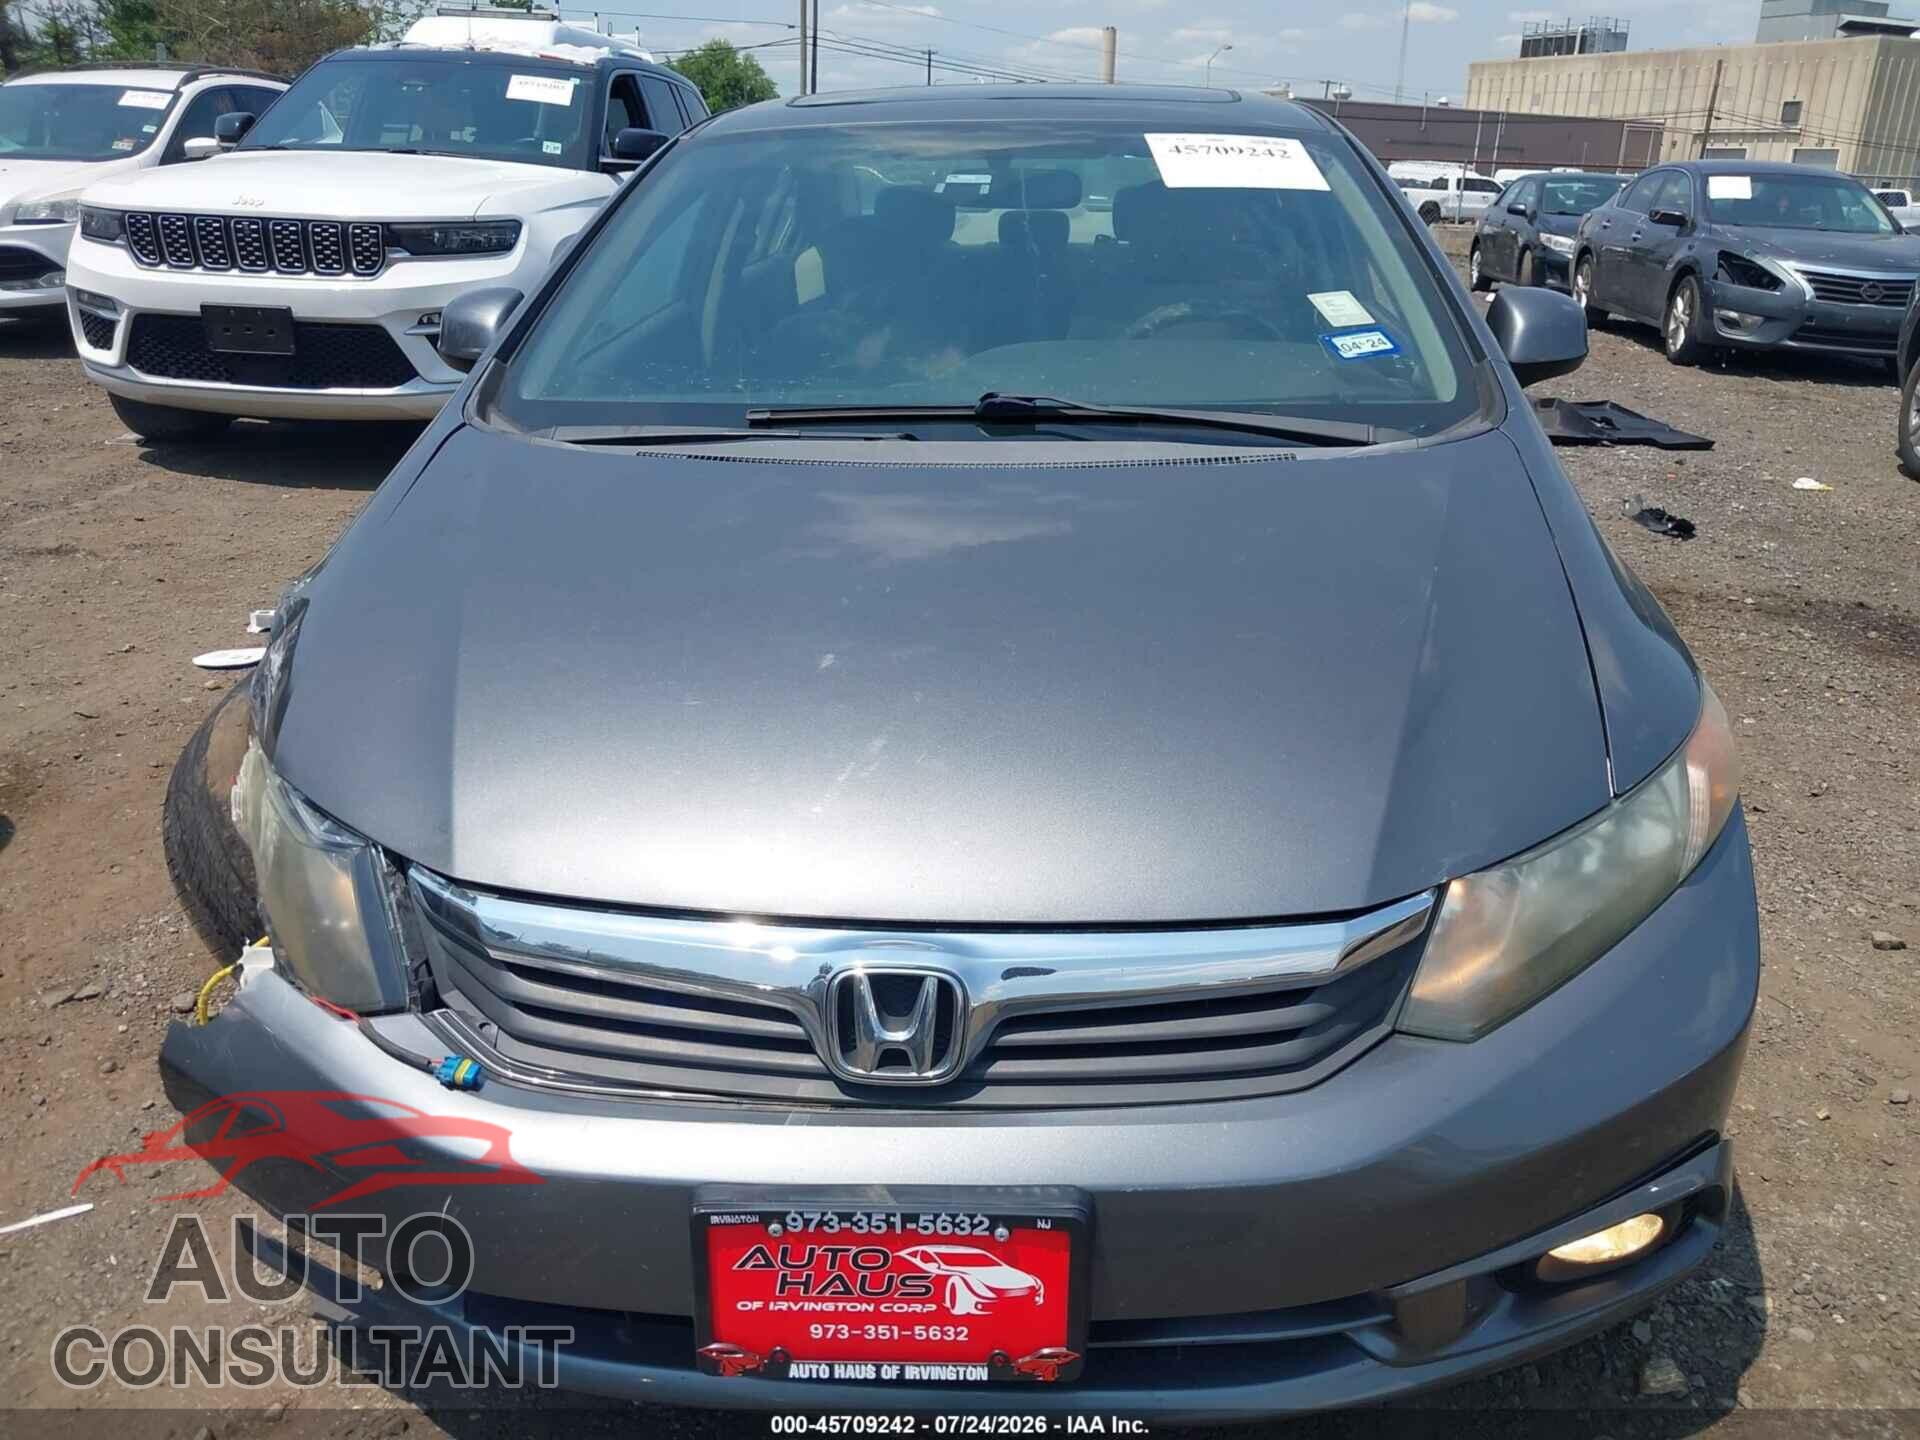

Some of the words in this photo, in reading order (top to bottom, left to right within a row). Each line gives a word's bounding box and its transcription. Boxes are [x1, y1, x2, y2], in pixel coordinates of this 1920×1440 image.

[232, 193, 265, 208] Jeep
[710, 1214, 760, 1225] IRVINGTON
[785, 1210, 990, 1236] 973-351-5632
[1036, 1219, 1052, 1230] NJ
[732, 1244, 892, 1272] AUTO
[776, 1271, 935, 1298] HAUS
[736, 1301, 764, 1312] OF
[769, 1301, 875, 1313] IRVINGTON
[879, 1302, 938, 1313] CORP
[809, 1323, 969, 1341] 973-351-5632
[788, 1363, 830, 1379] AUTO
[834, 1364, 877, 1379] HAUS
[881, 1365, 900, 1380] OF
[905, 1366, 989, 1381] IRVINGTON
